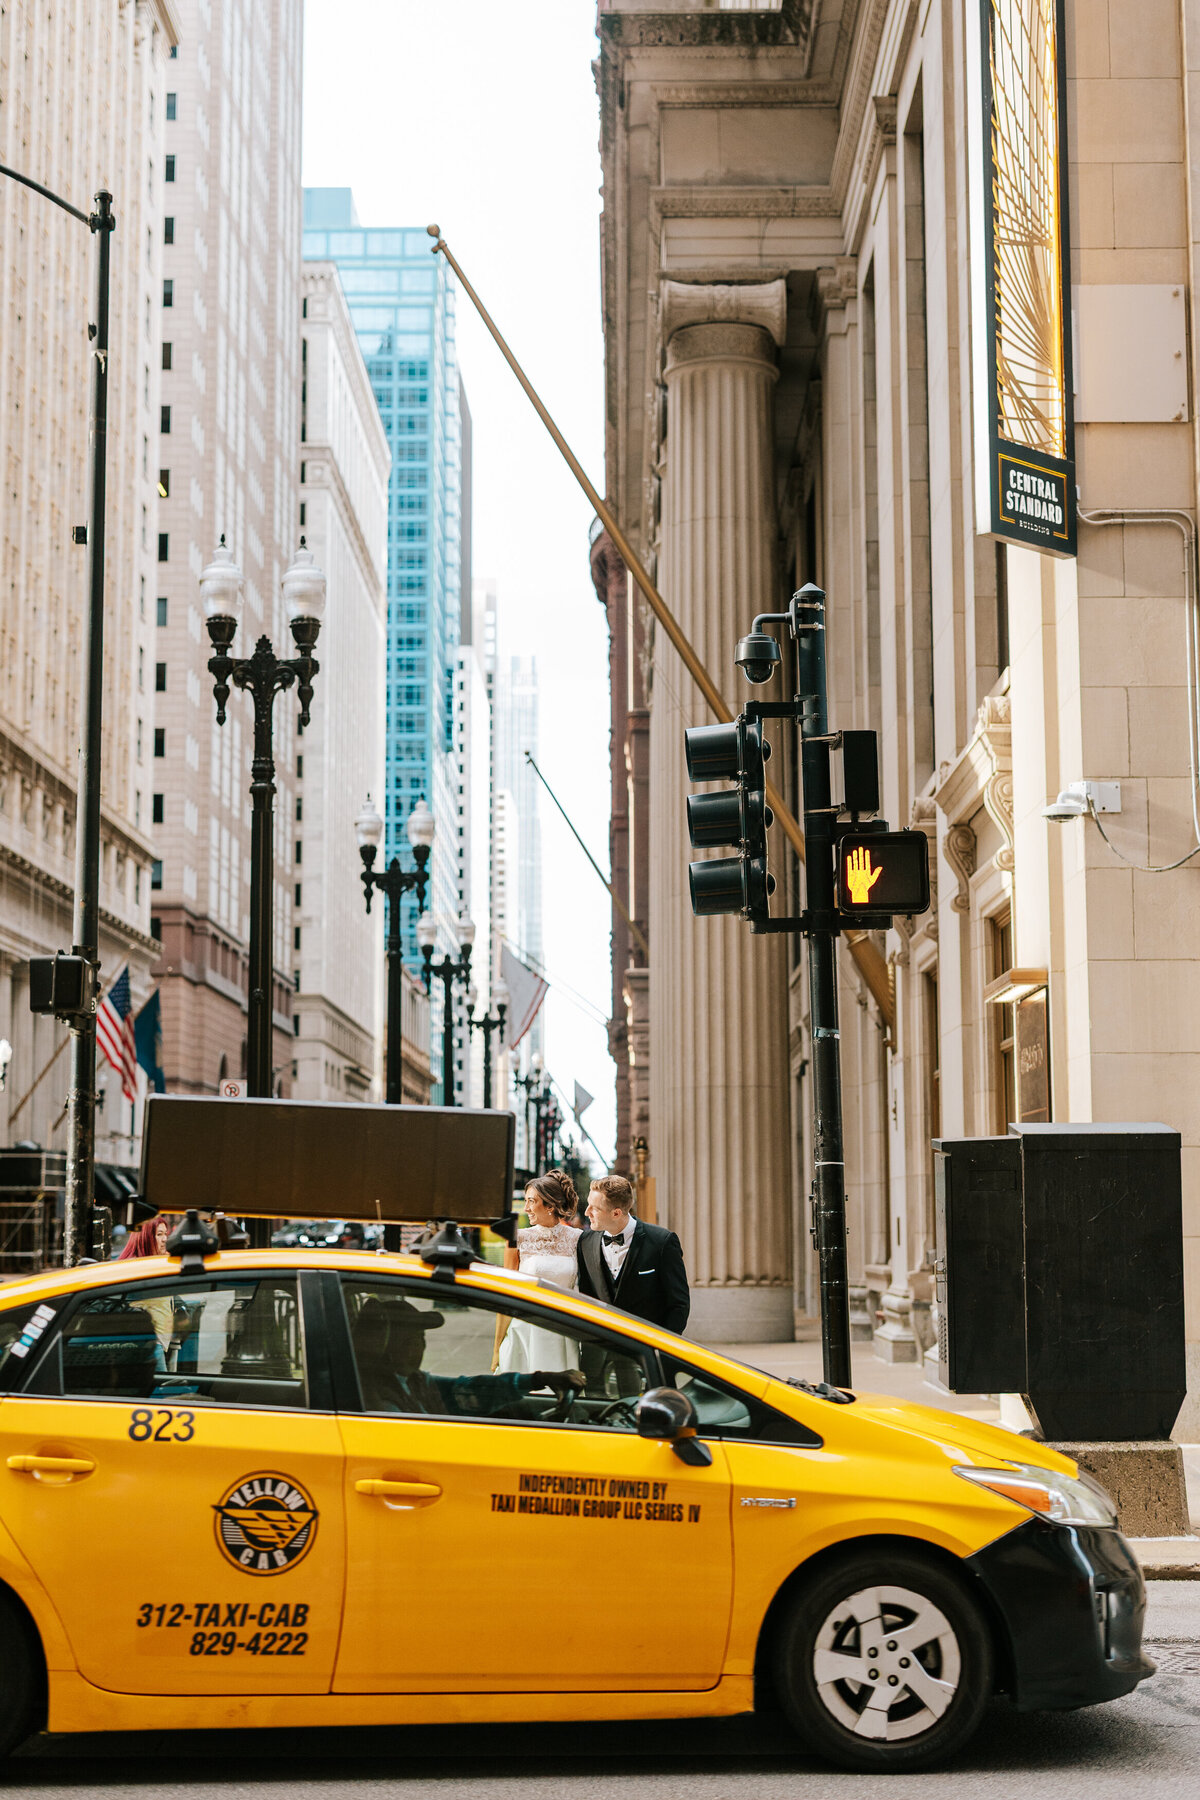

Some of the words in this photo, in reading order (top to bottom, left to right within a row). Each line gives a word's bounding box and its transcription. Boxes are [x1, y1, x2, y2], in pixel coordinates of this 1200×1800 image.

[1009, 469, 1058, 502] CENTRAL
[1006, 490, 1063, 525] STANDARD
[128, 1409, 195, 1442] 823
[229, 1479, 306, 1510] YELLOW
[519, 1474, 607, 1496] INDEPENDENTLY
[609, 1479, 650, 1499] OWNED
[652, 1482, 668, 1500] BY
[491, 1494, 516, 1513] TAXI
[518, 1496, 580, 1517] MEDALLION
[582, 1499, 621, 1519] GROUP
[623, 1501, 643, 1520] LLC
[645, 1503, 683, 1522] SERIES
[688, 1504, 701, 1523] IV
[239, 1547, 288, 1570] CAB
[137, 1603, 309, 1627] 312-TAXI-CAB
[189, 1631, 309, 1656] 829-4222
